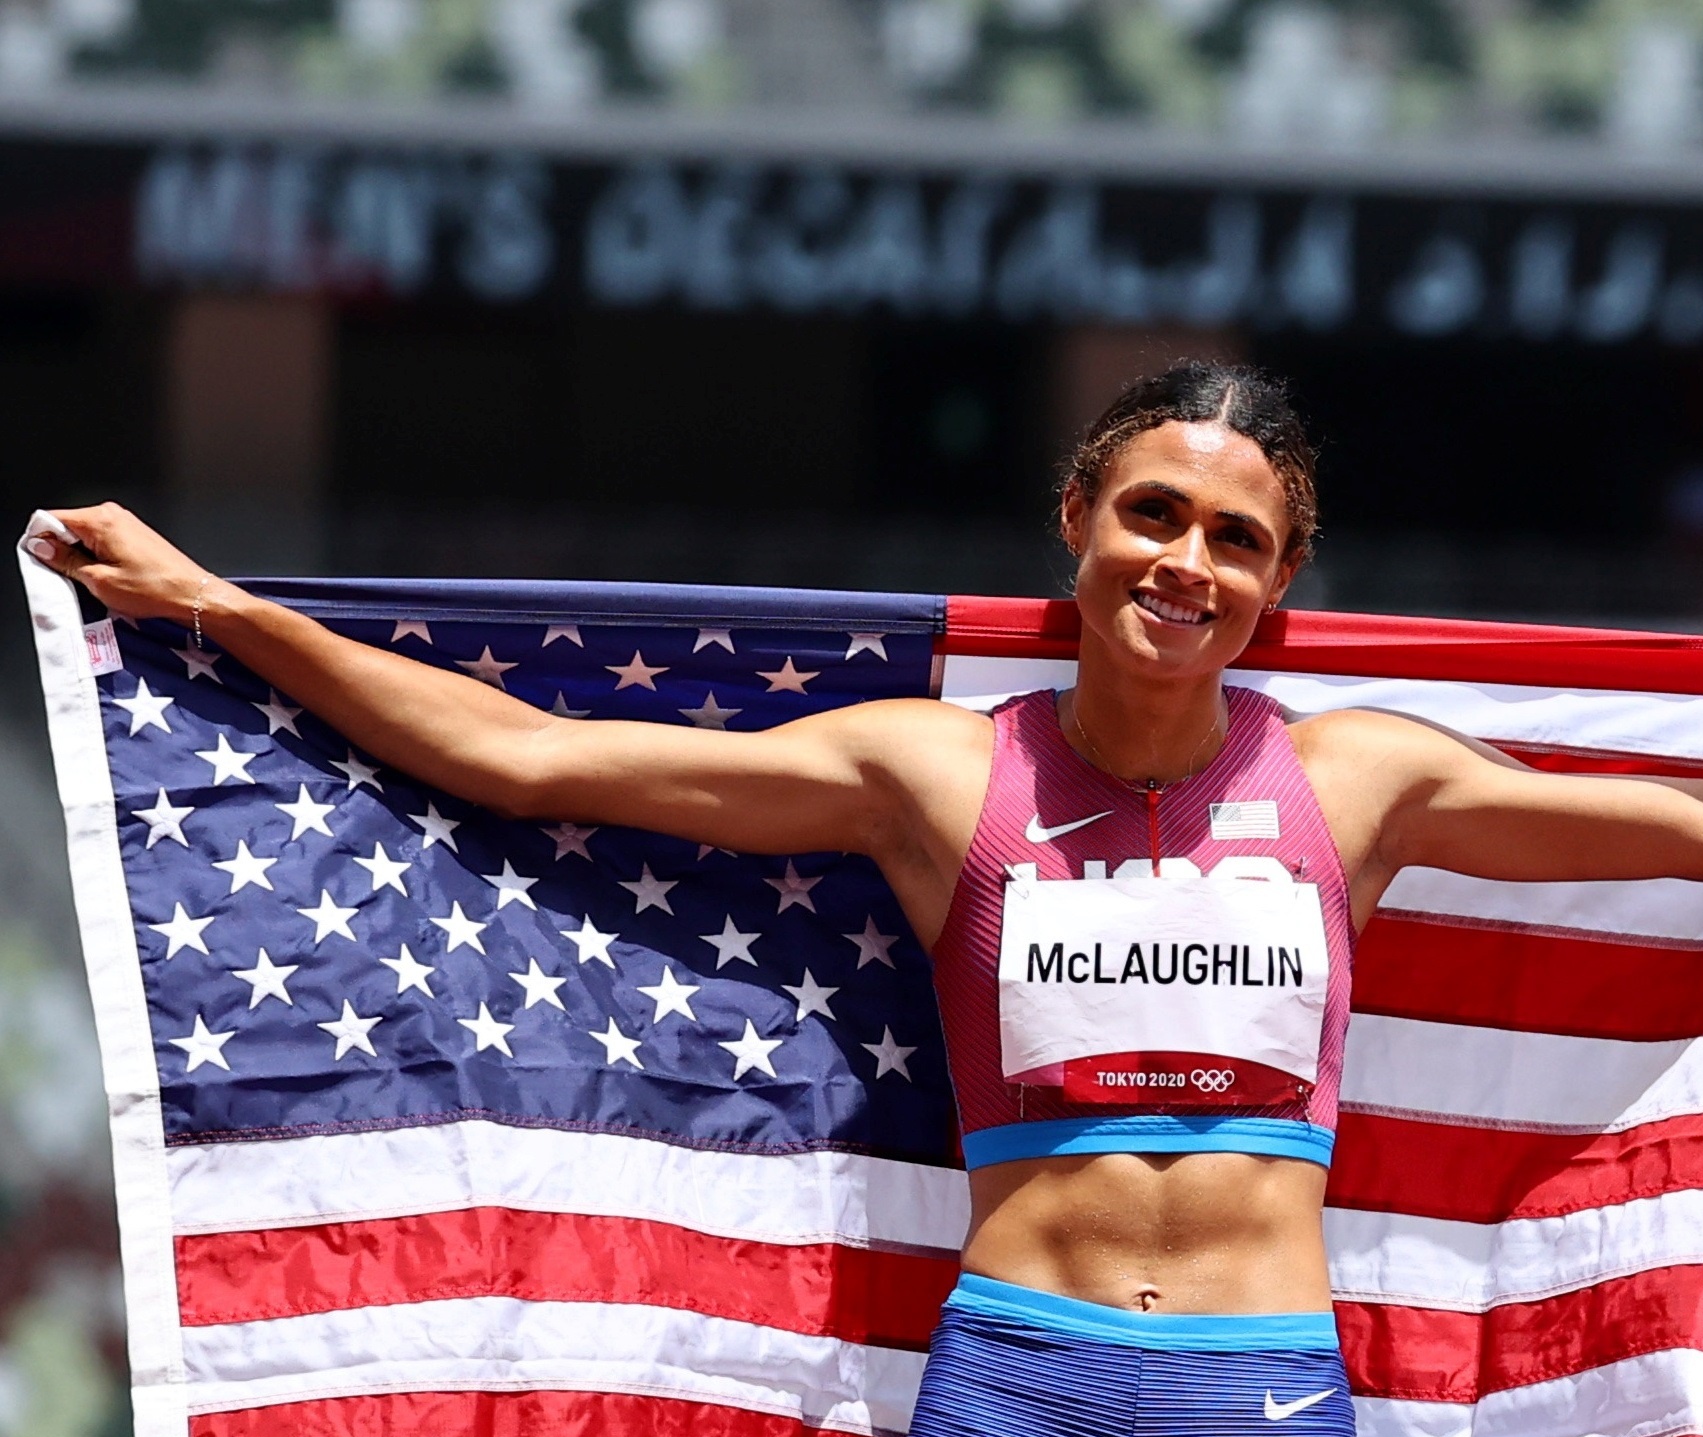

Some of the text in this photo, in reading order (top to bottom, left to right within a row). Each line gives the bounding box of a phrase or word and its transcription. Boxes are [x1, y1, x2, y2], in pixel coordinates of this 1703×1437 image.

[1026, 942, 1303, 987] McLAUGHLIN
[1097, 1071, 1186, 1087] TOKYO 2020
